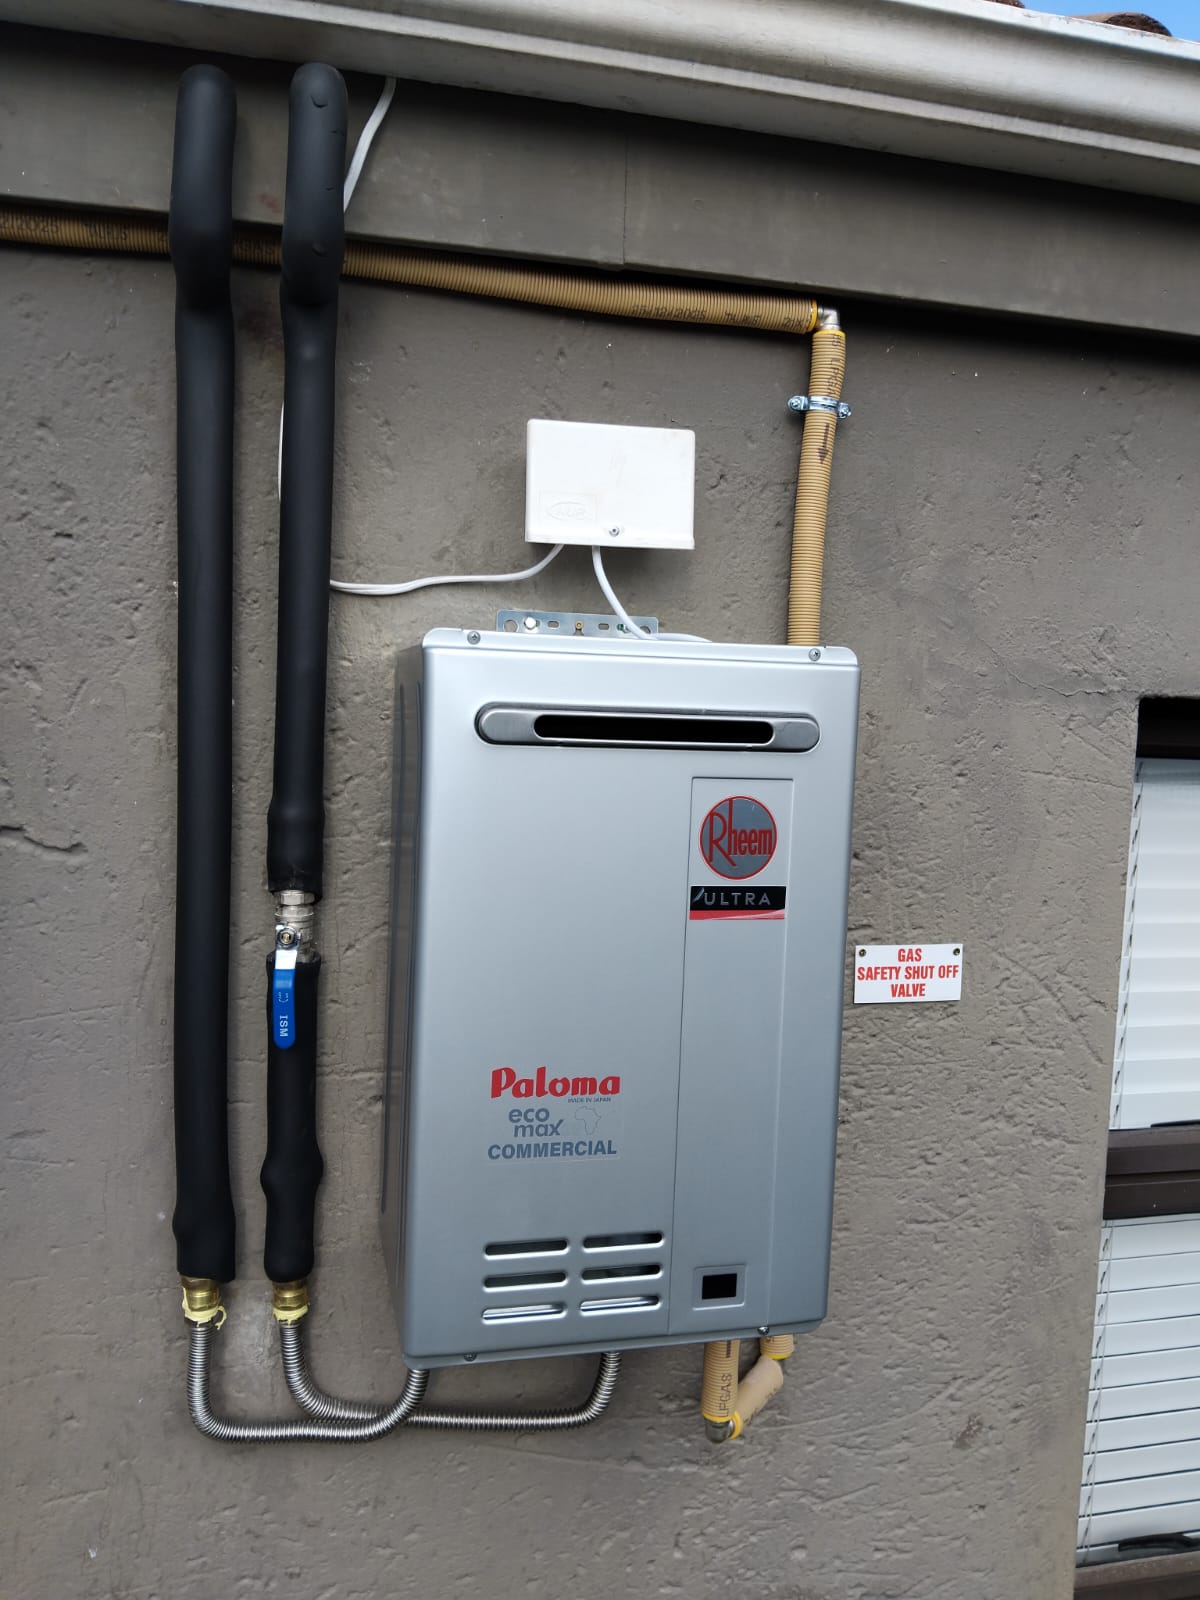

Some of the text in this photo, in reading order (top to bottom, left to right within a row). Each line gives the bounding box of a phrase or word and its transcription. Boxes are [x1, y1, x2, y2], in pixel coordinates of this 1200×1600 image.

[708, 798, 772, 866] Rheem
[703, 891, 771, 906] ULTRA
[897, 948, 922, 962] GAS
[857, 964, 960, 981] SAFETY SHUT OFF
[891, 983, 926, 998] VALVE
[279, 1014, 289, 1037] ISM
[491, 1066, 621, 1099] Paloma
[508, 1107, 550, 1124] eco
[513, 1119, 564, 1138] max
[487, 1140, 618, 1160] COMMERCIAL
